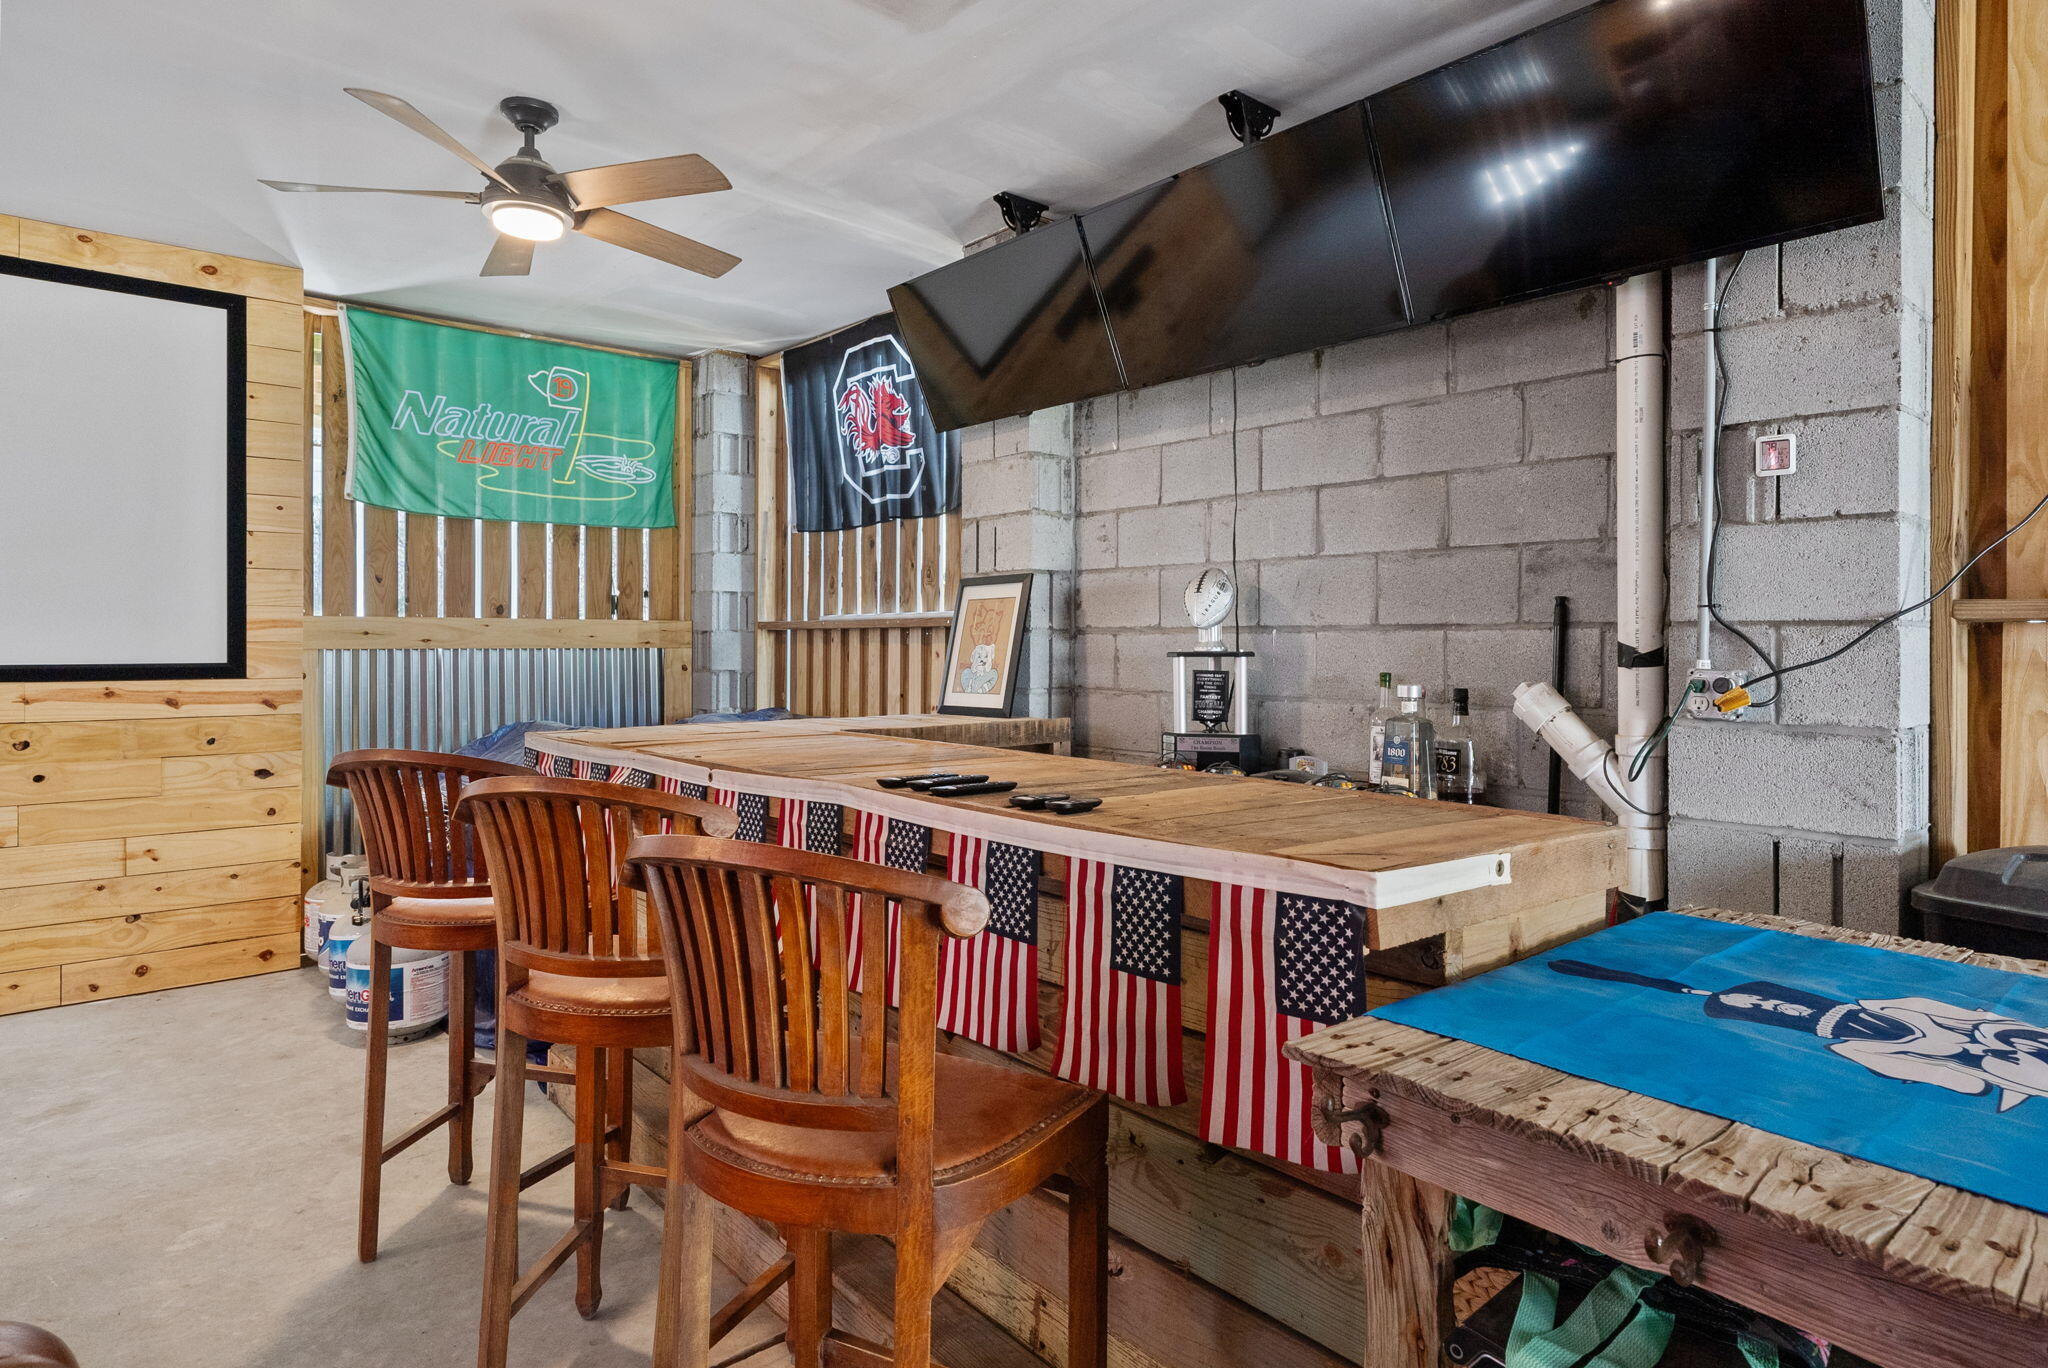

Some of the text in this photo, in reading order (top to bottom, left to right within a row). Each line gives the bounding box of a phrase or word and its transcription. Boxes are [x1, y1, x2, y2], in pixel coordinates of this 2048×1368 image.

[552, 376, 573, 399] 19
[392, 389, 579, 449] Natural
[457, 439, 564, 471] LIGHT
[1201, 591, 1222, 616] LEAGUE
[1387, 747, 1406, 757] 1800
